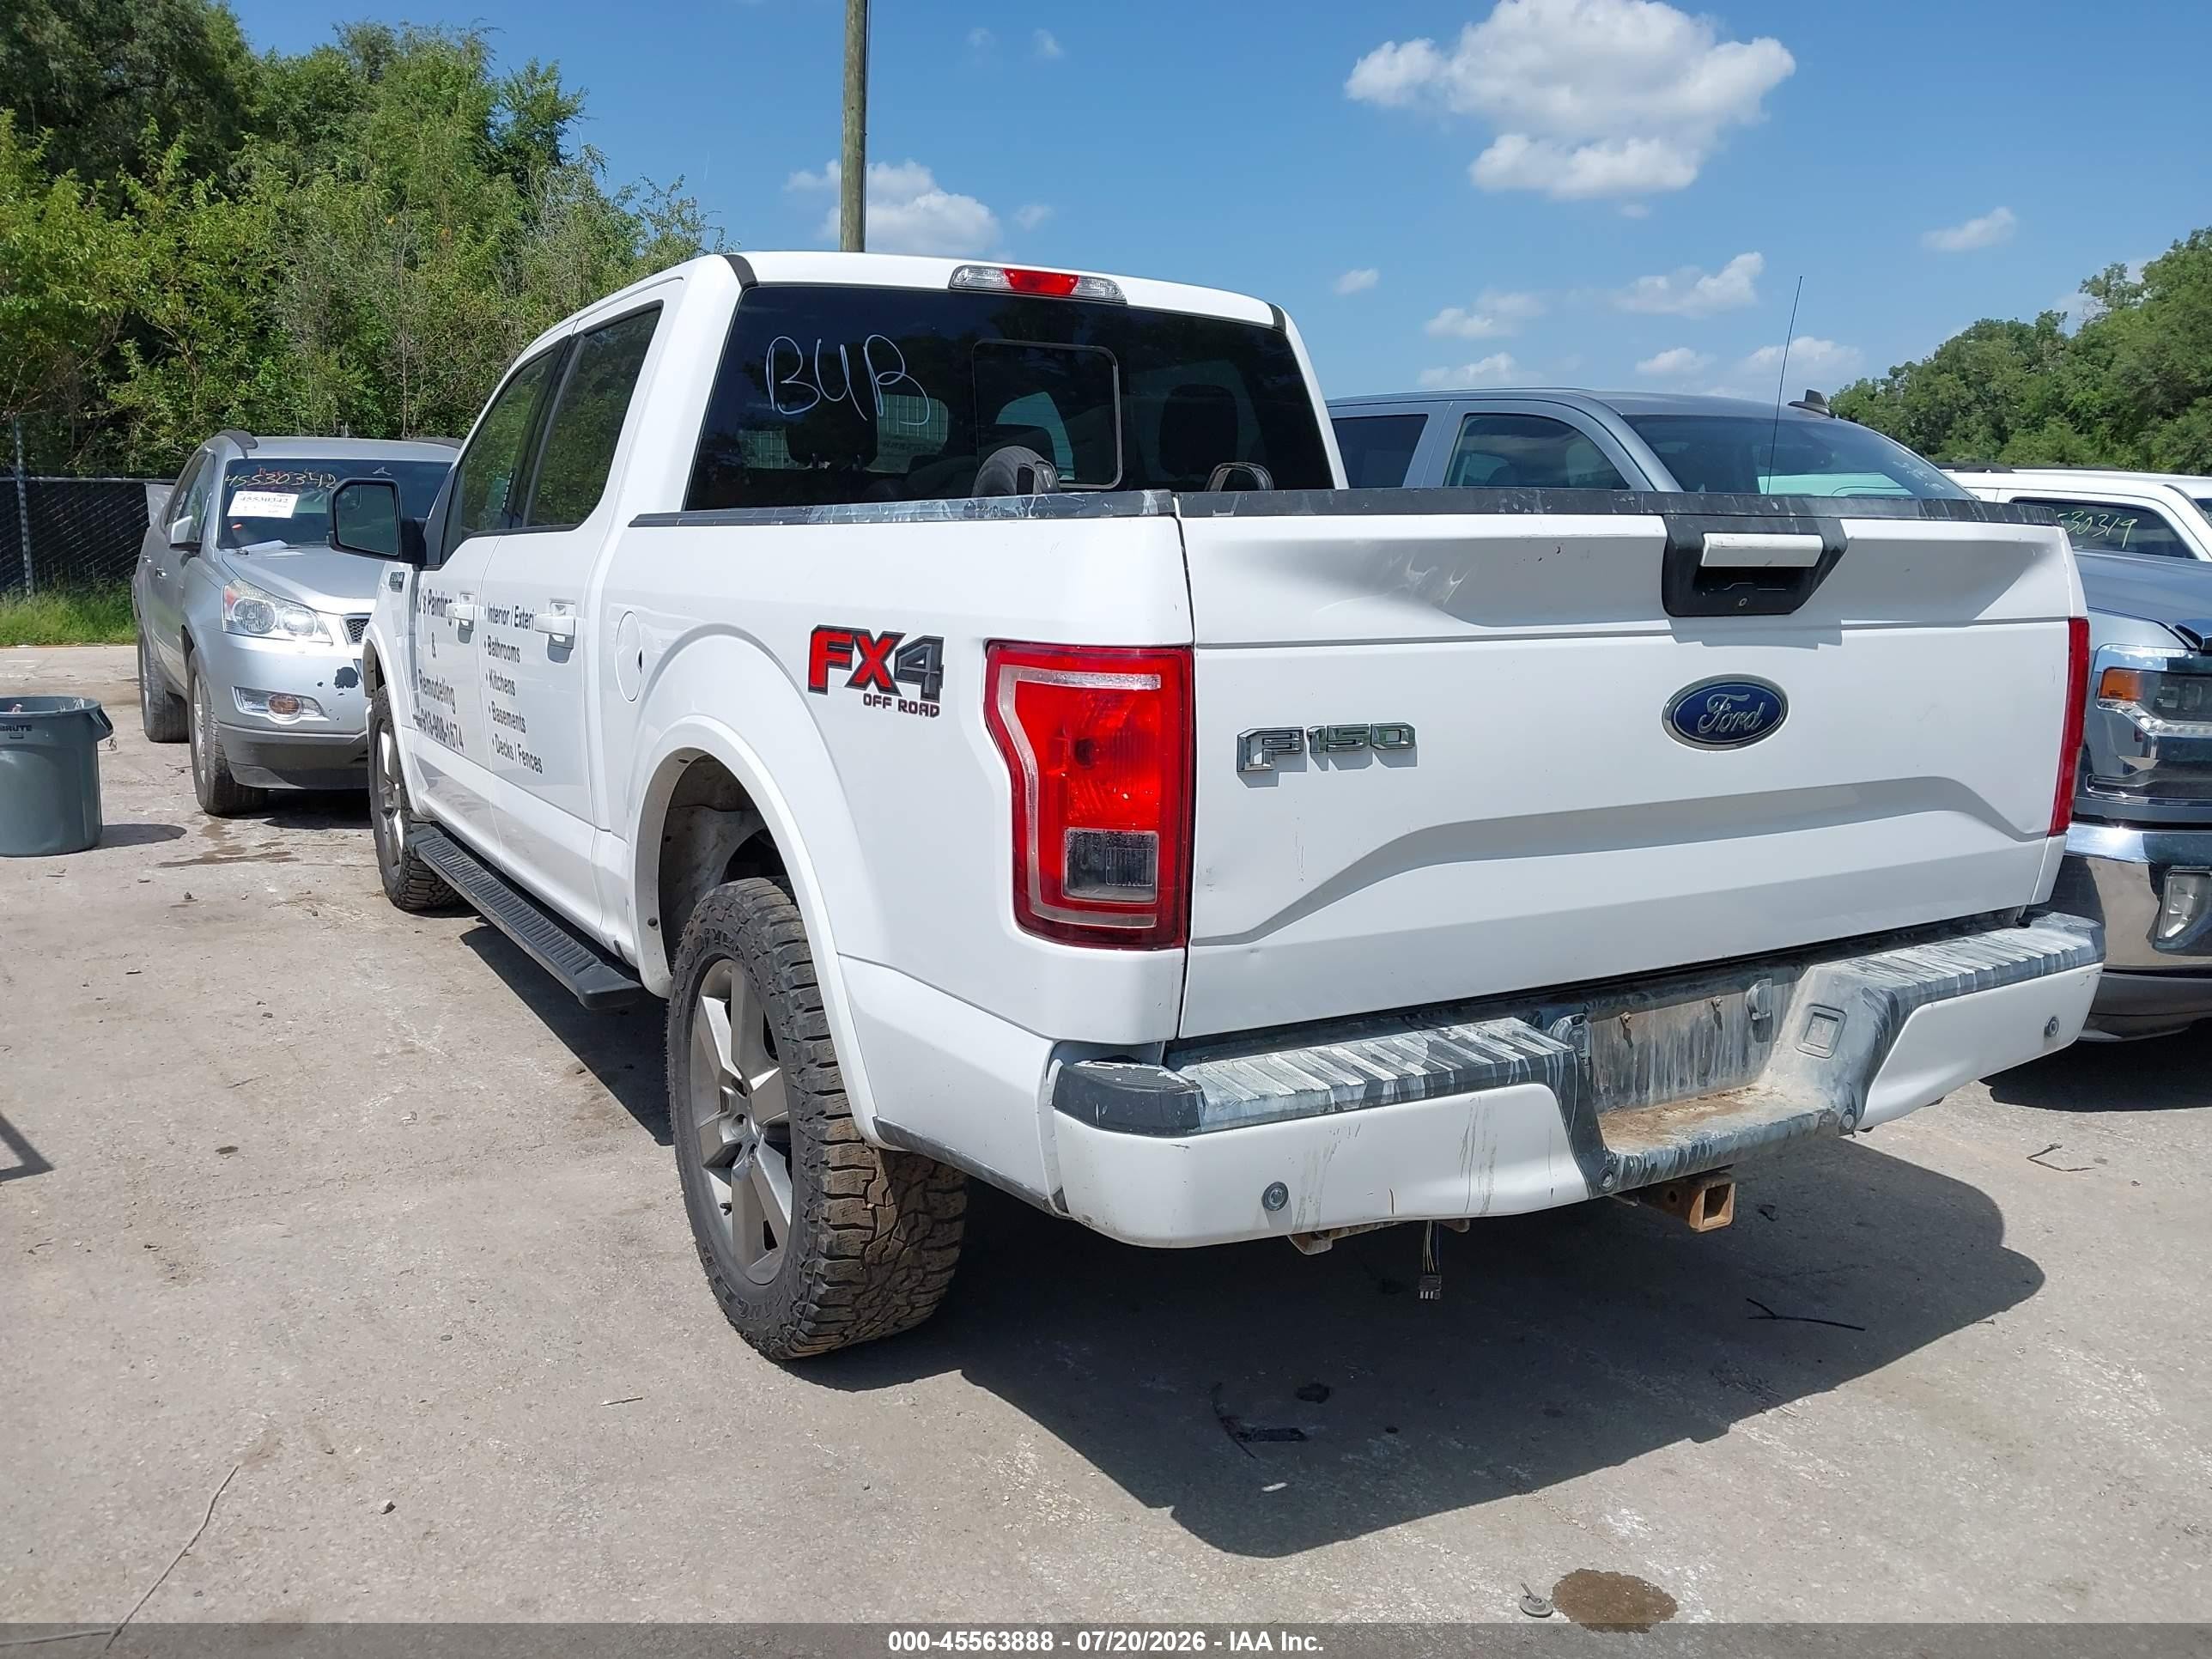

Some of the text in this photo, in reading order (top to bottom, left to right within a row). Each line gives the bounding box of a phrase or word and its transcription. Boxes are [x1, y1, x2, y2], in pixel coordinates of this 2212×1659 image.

[488, 601, 510, 626] Interior
[514, 605, 537, 631] Exteri
[431, 631, 437, 659] &
[487, 635, 520, 664] Bathrooms
[808, 624, 945, 703] FX4
[418, 668, 456, 715] Remodeling
[489, 667, 516, 697] Kitchens
[491, 700, 526, 734] Basements
[863, 693, 940, 718] OFF ROAD
[1698, 693, 1765, 734] Ford
[495, 732, 514, 762] Decks
[517, 743, 543, 775] Fences
